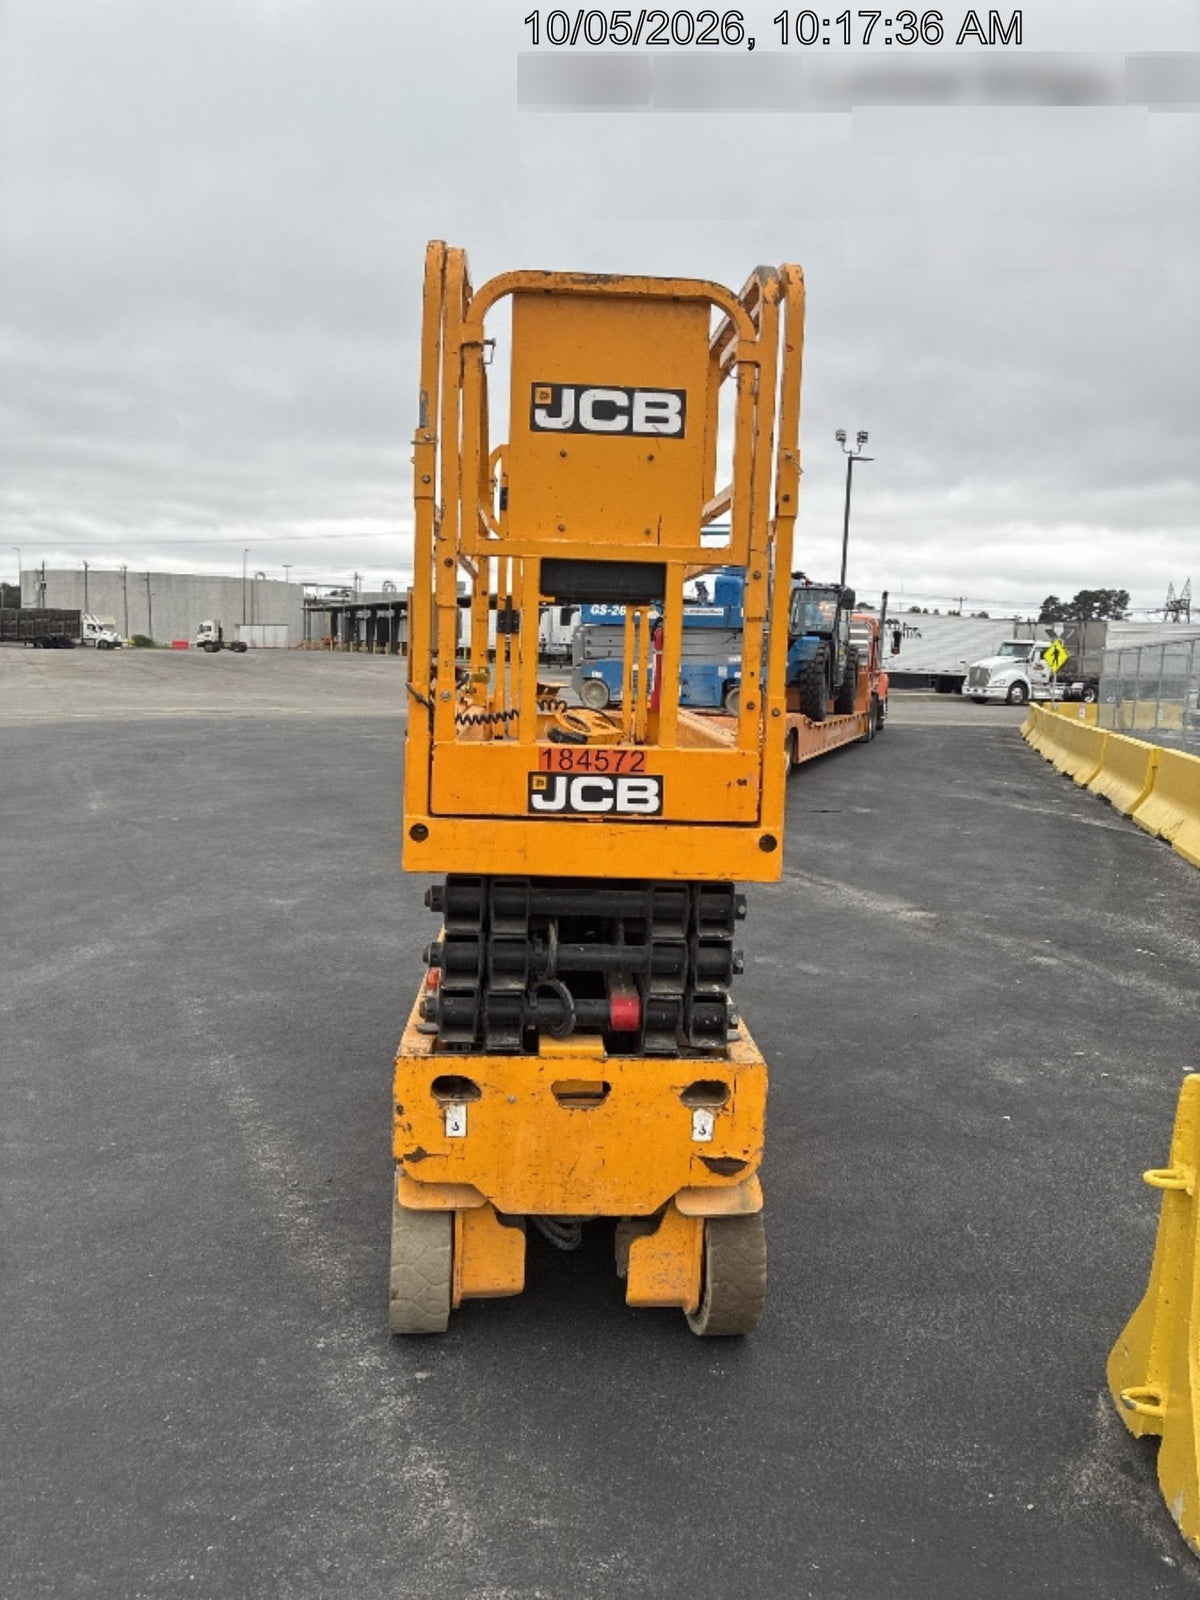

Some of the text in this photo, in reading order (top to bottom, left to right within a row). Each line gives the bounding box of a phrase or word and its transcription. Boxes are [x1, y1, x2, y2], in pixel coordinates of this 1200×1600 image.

[534, 388, 682, 434] JCB
[541, 748, 646, 772] 184572
[531, 776, 660, 813] JCB
